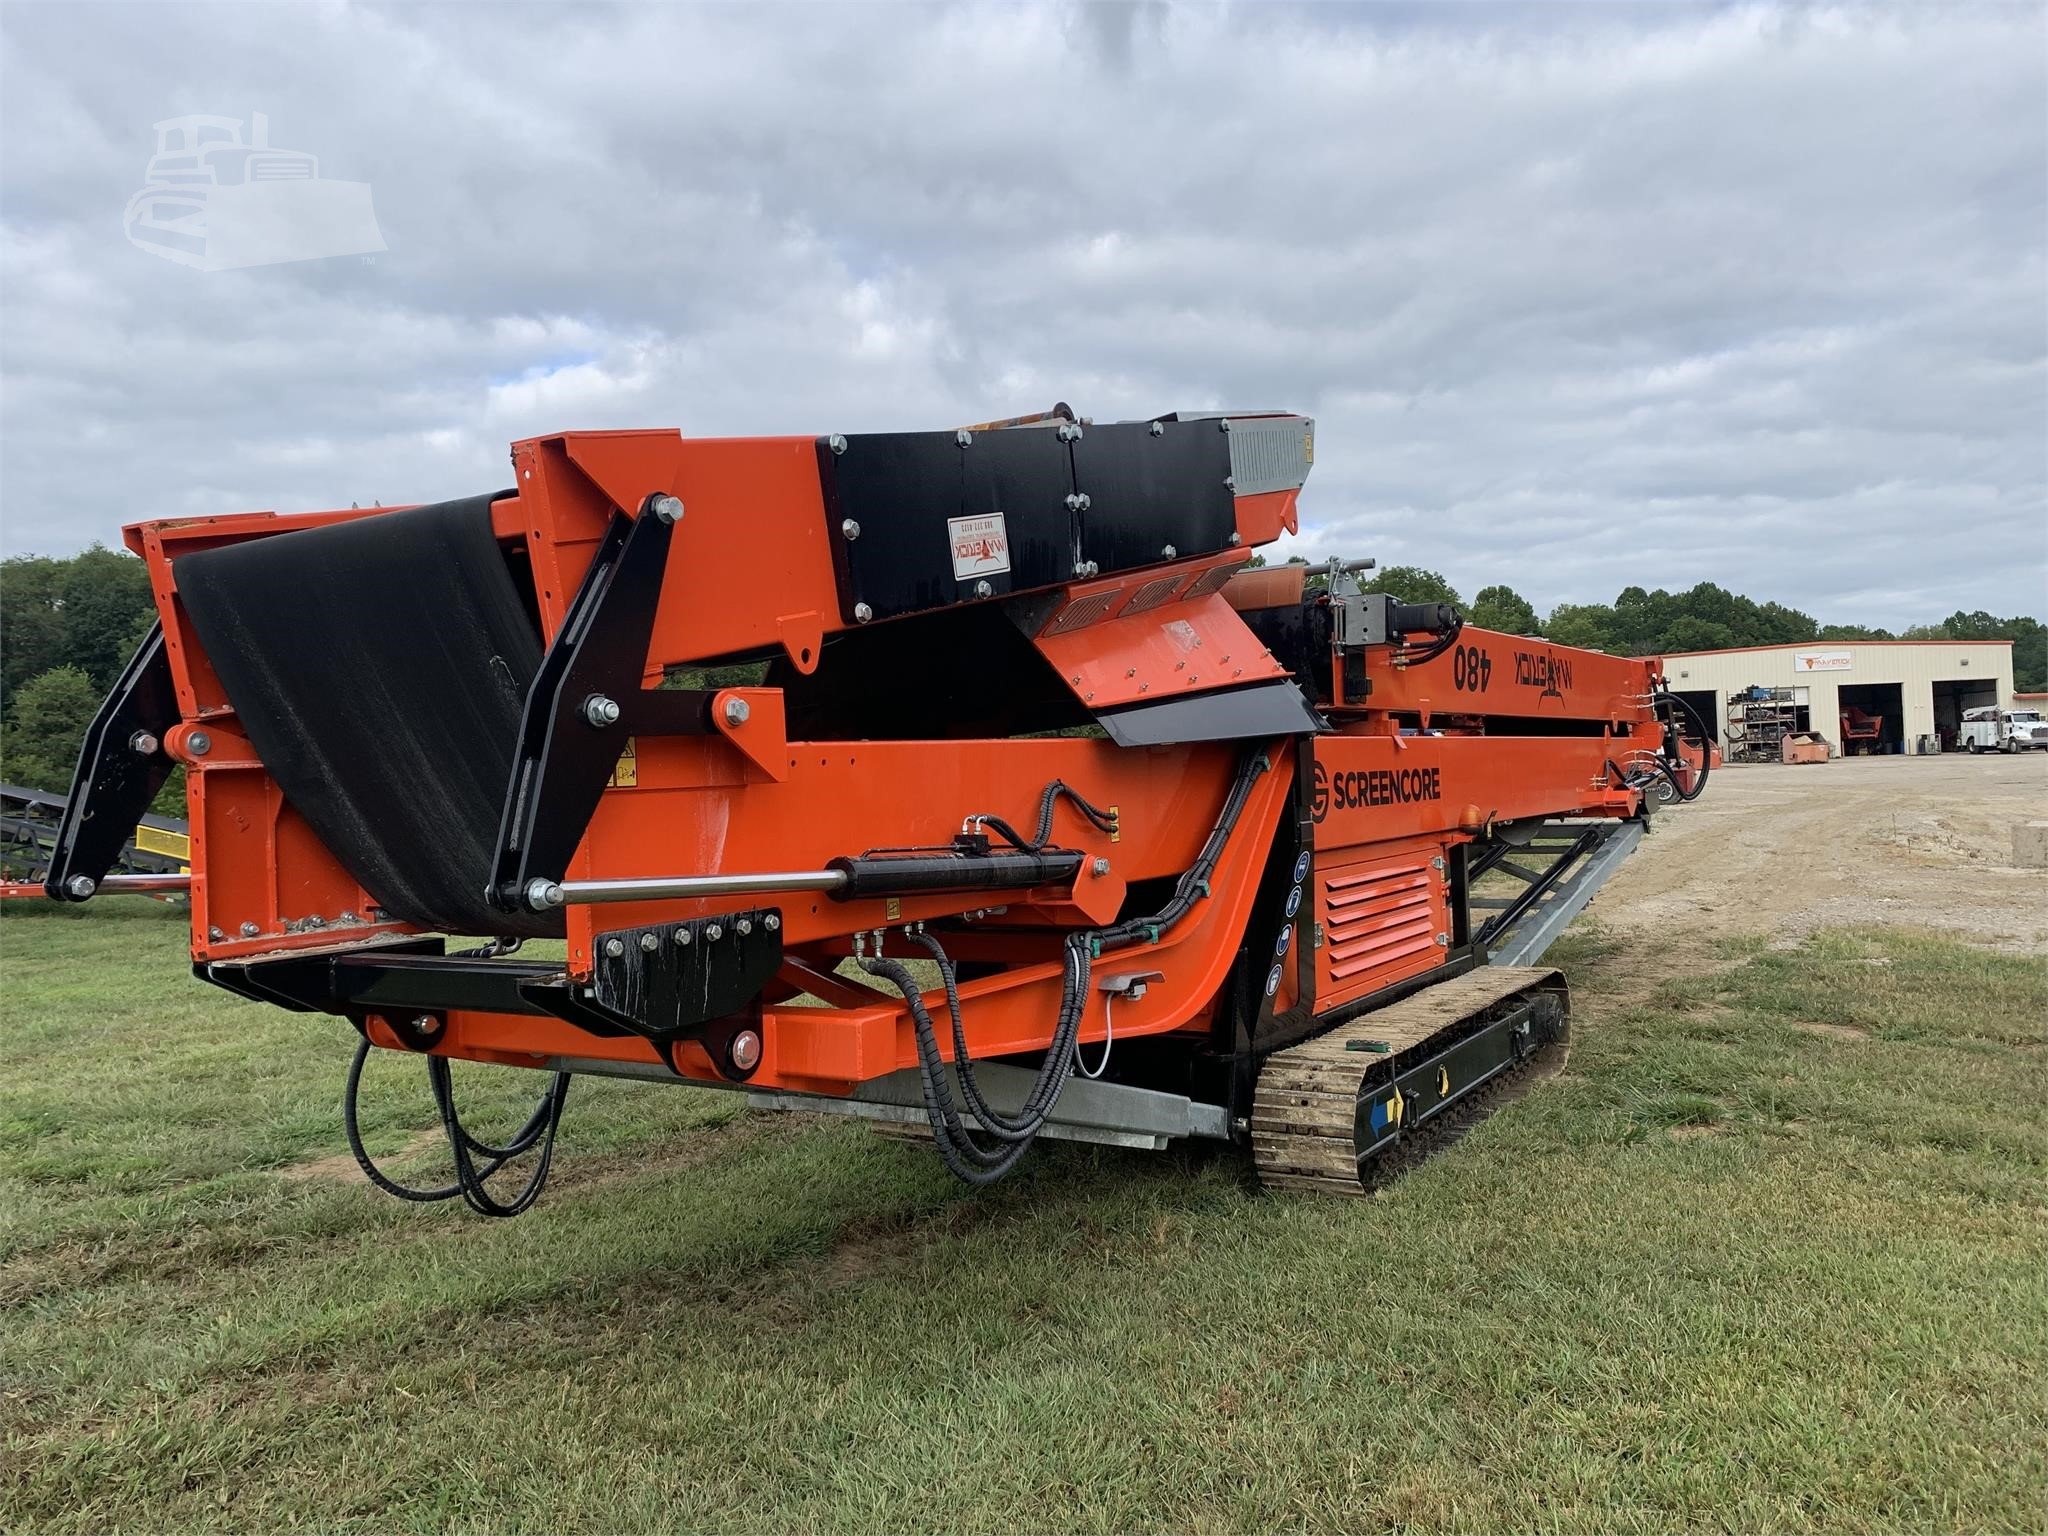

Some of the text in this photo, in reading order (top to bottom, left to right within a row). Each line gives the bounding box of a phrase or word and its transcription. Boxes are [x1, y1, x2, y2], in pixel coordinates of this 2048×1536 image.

[955, 539, 1006, 559] MAVERICK
[1454, 644, 1491, 693] 480
[1514, 649, 1573, 692] MAVERICK
[1333, 767, 1440, 809] SCREENCORE
